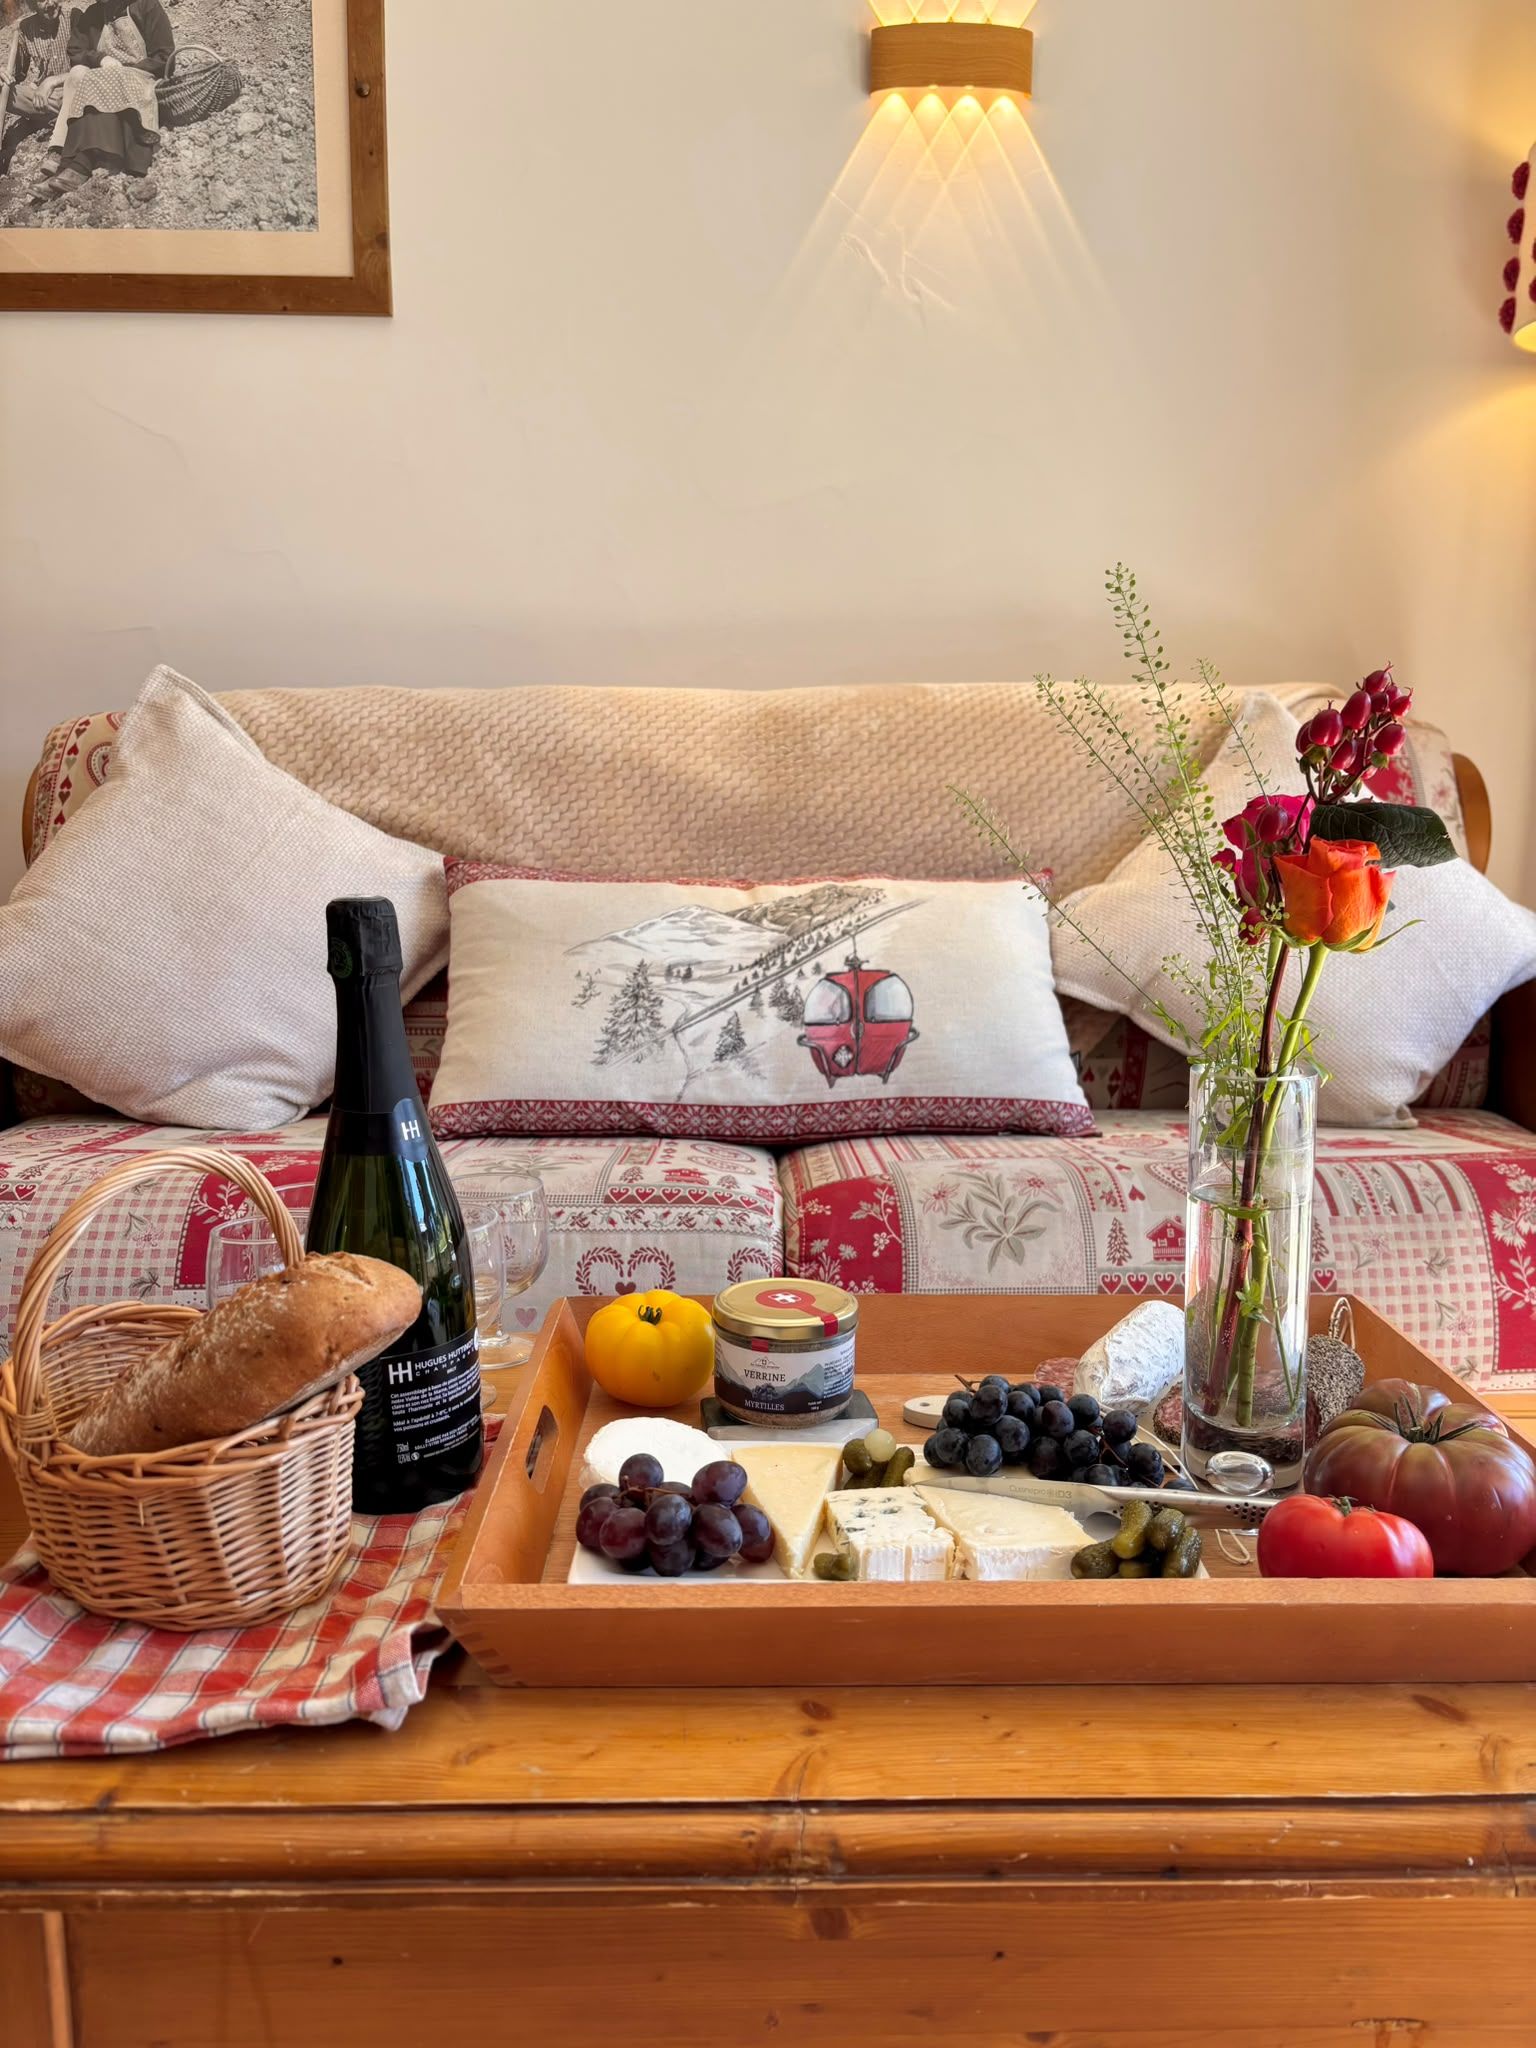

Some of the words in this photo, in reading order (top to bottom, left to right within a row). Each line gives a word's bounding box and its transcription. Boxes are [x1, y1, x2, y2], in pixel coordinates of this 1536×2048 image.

[414, 1354, 447, 1371] HUGUES
[743, 1368, 786, 1382] VERRINE
[744, 1399, 785, 1411] MYRTILLES
